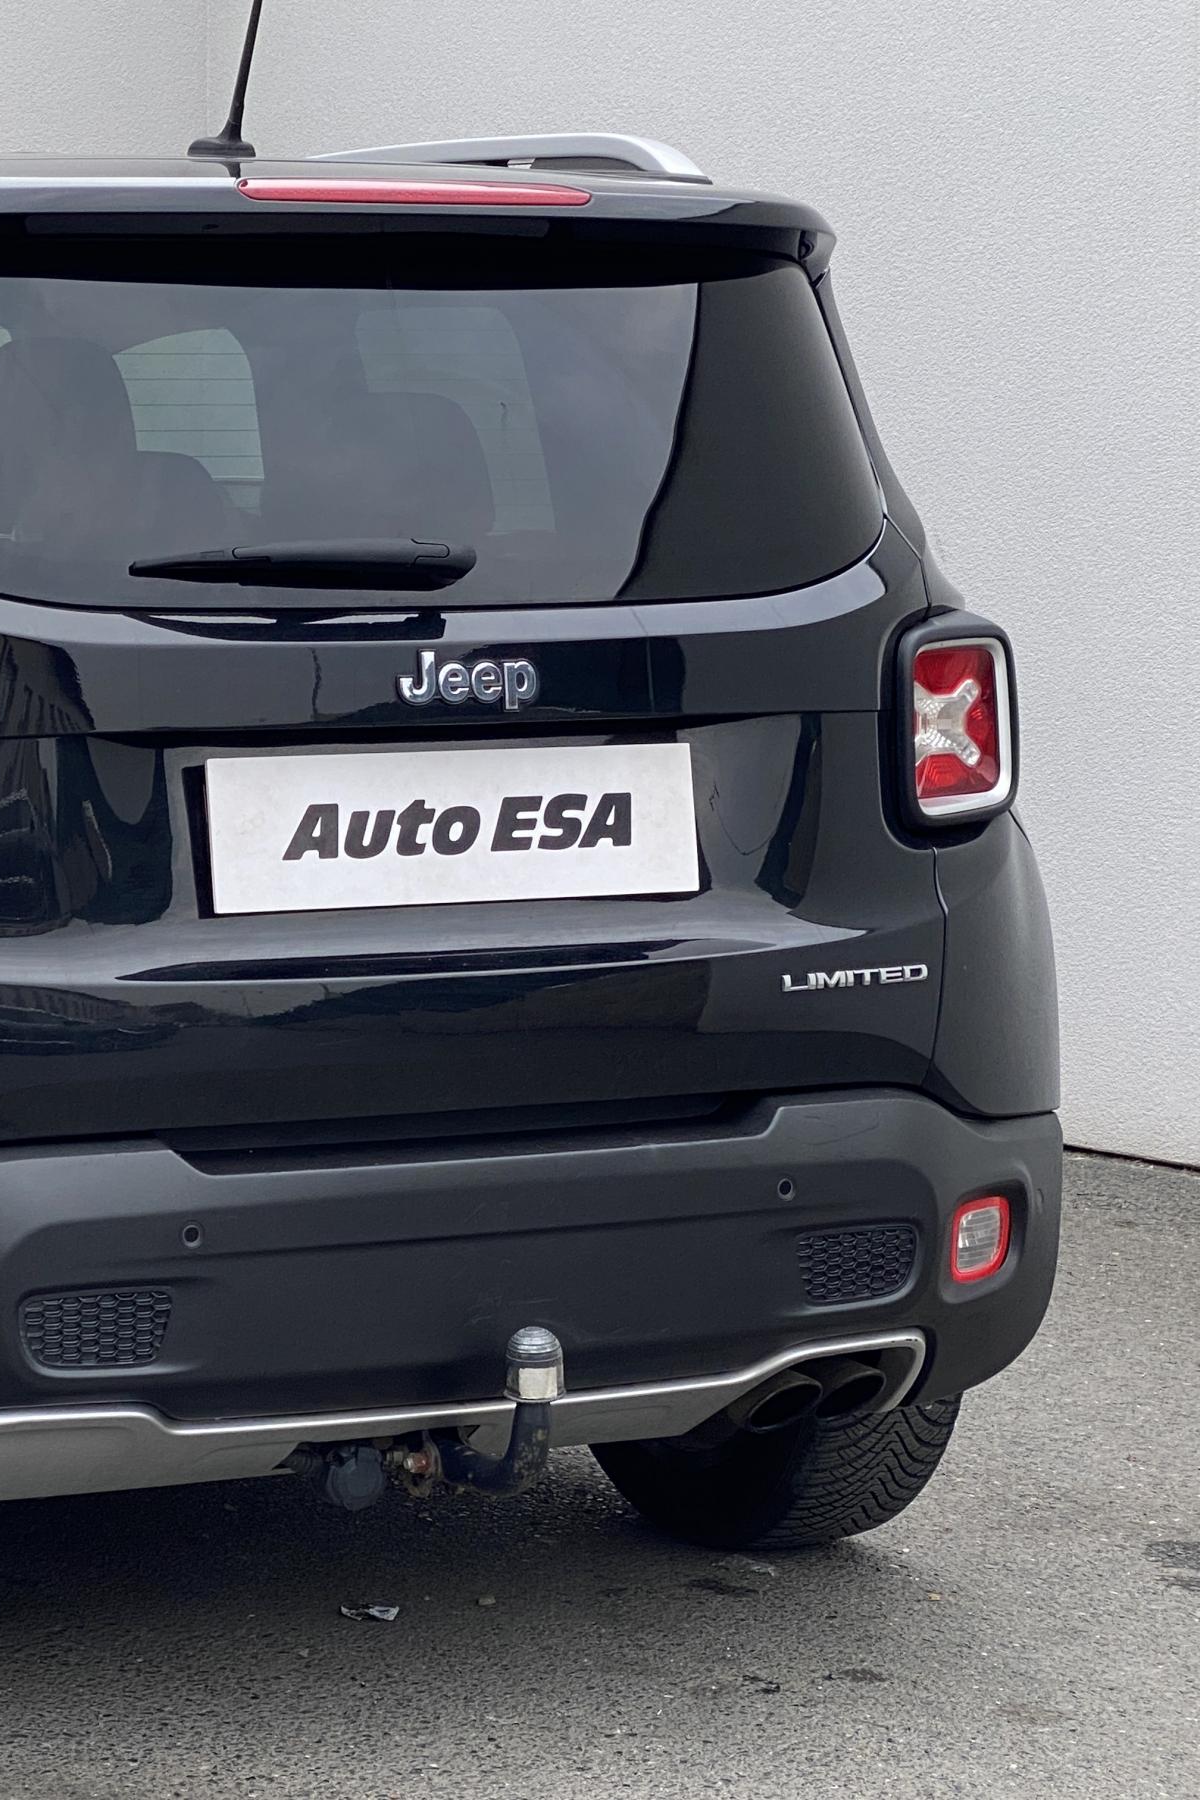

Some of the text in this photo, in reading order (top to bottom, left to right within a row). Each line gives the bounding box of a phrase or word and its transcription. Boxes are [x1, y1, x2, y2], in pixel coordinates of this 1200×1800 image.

[397, 650, 538, 711] Jeep
[282, 792, 632, 861] Auto ESA
[781, 964, 928, 992] LIMITED
